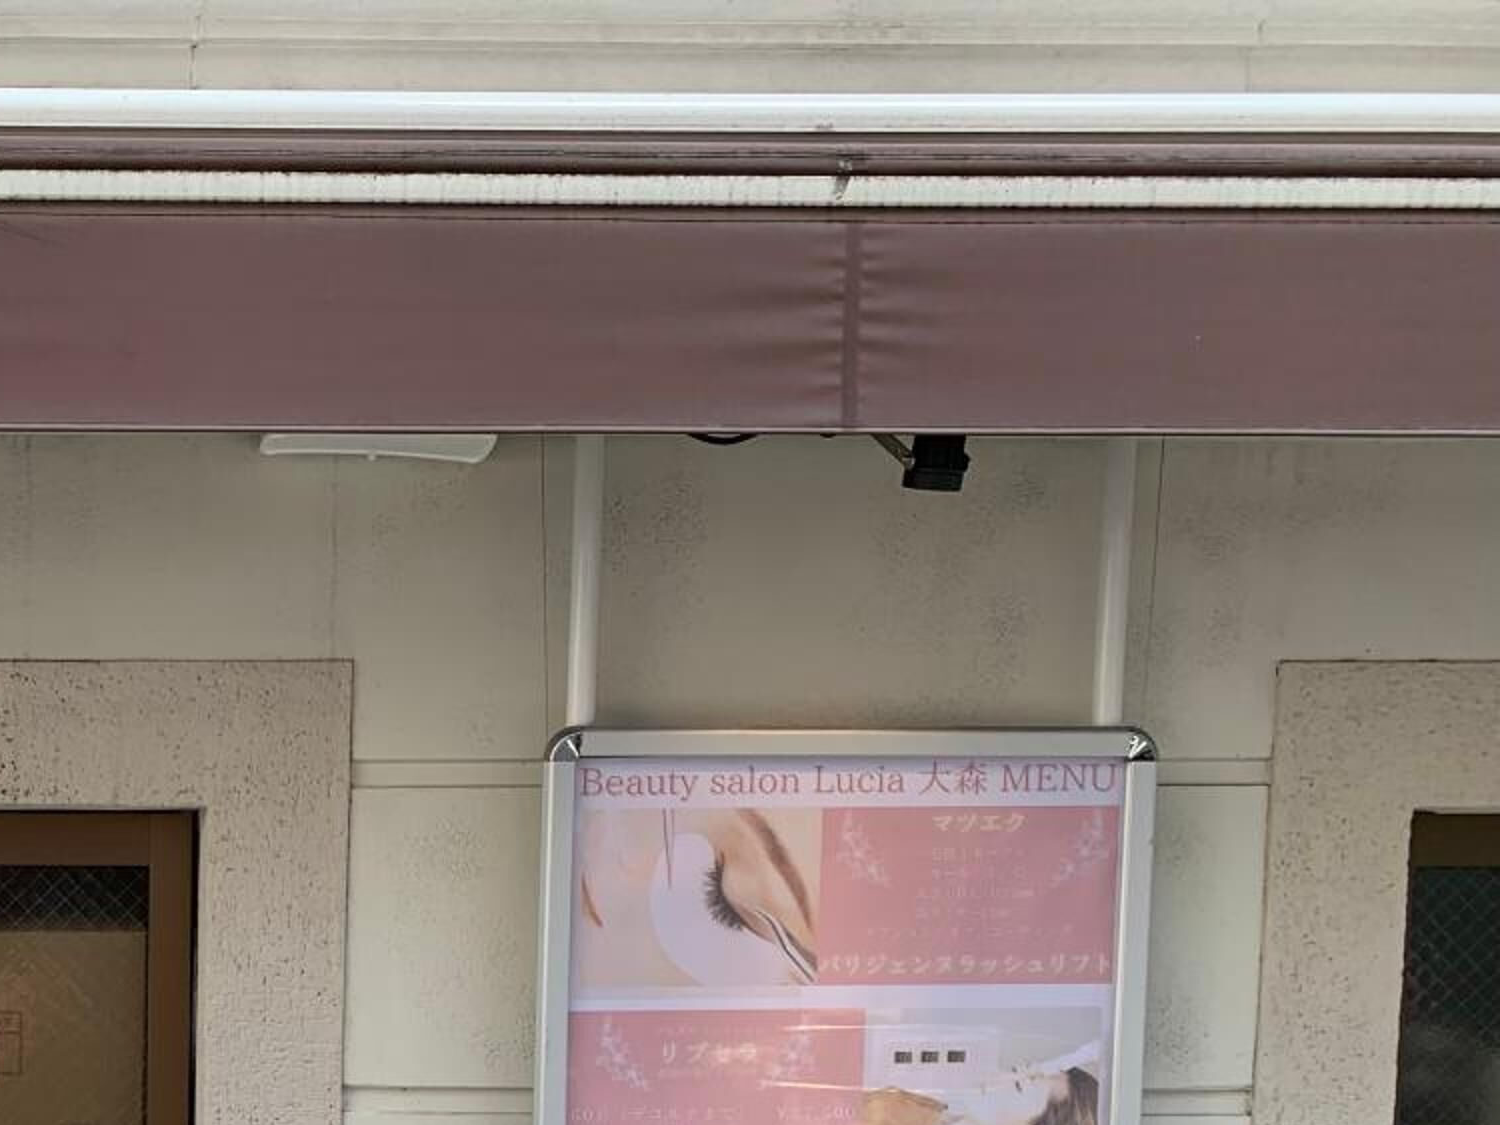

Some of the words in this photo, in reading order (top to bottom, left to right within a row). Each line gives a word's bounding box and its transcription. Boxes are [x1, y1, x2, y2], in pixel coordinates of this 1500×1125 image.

[580, 766, 699, 801] Beauty
[709, 764, 800, 795] salon
[813, 764, 905, 794] Lucia
[916, 760, 988, 796] 大森
[1001, 762, 1118, 793] MENU
[931, 812, 1026, 833] マツエク
